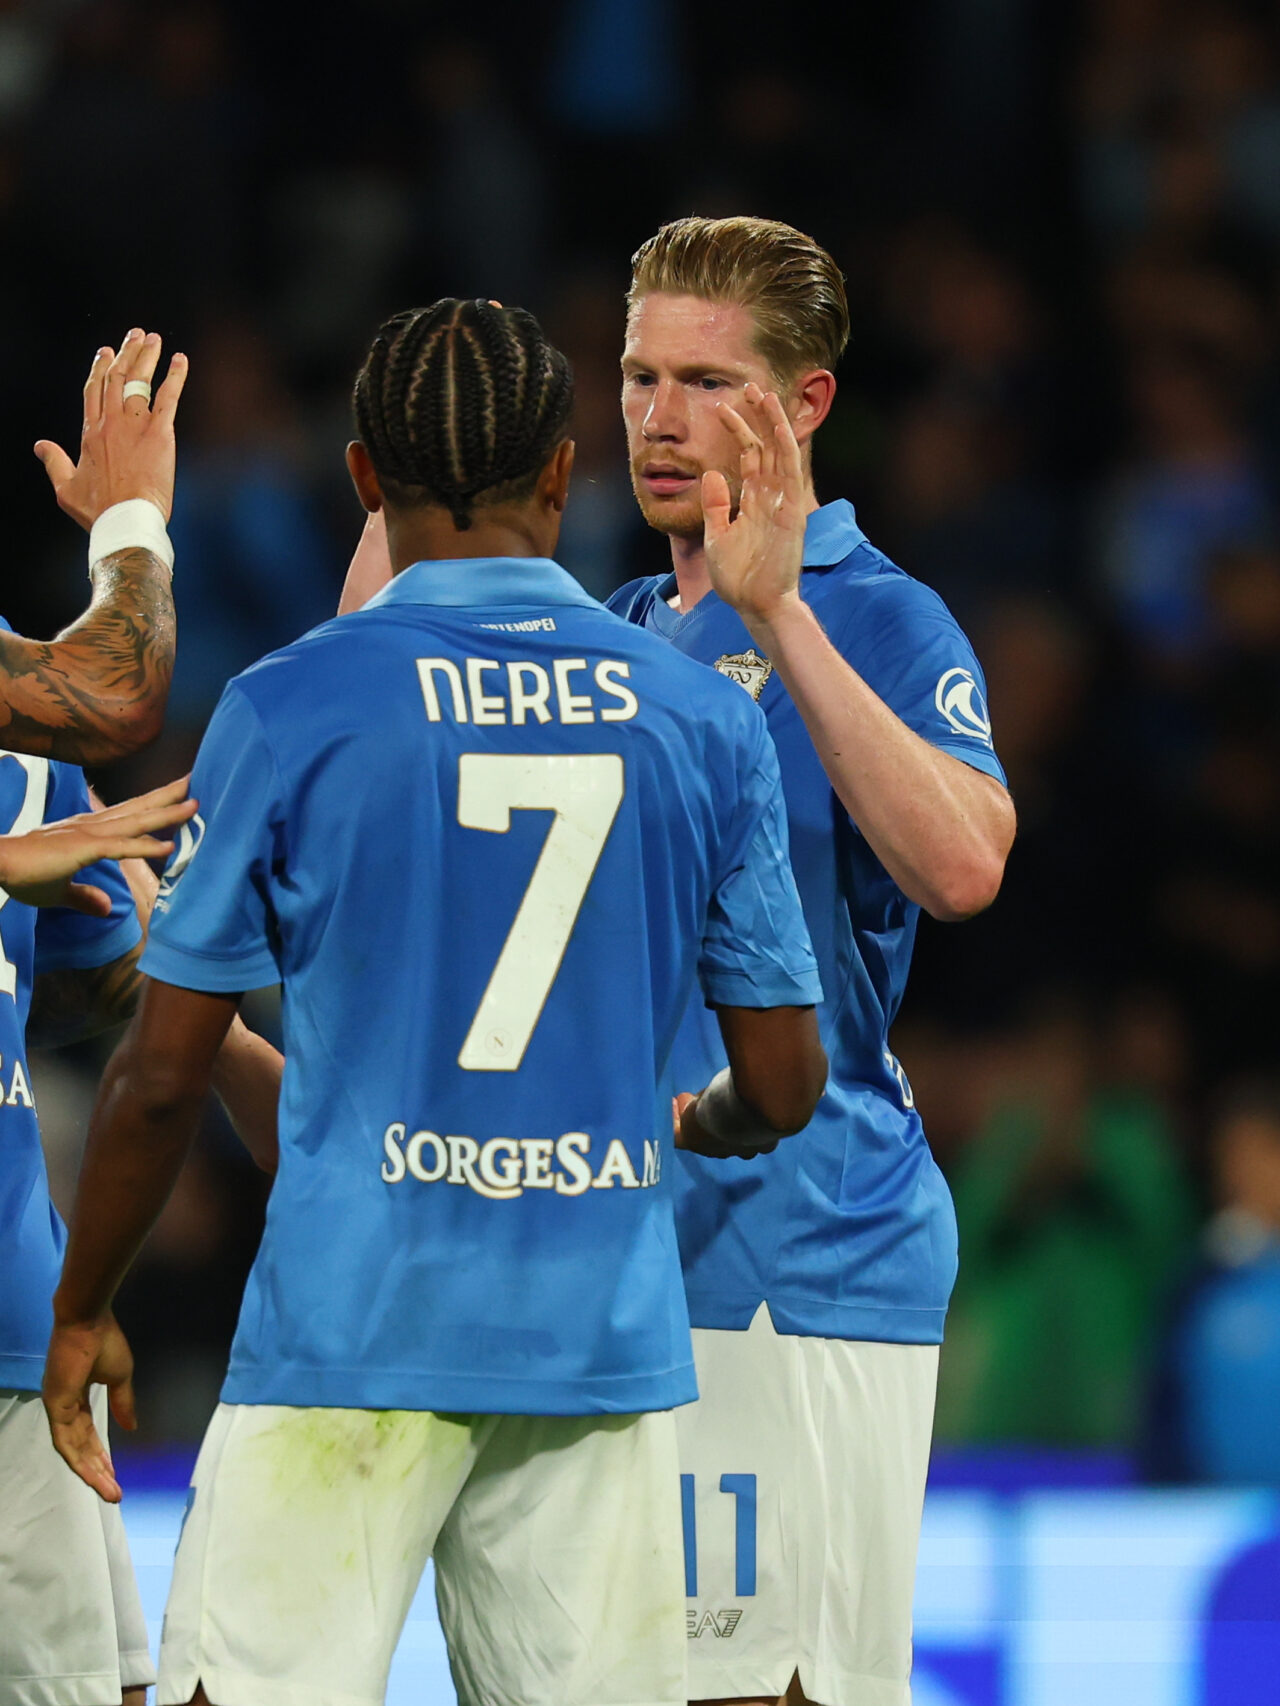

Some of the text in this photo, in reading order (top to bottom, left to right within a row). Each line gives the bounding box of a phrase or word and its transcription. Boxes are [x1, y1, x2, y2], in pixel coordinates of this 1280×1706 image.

[417, 657, 638, 724] NERES
[458, 754, 623, 1070] 7
[381, 1122, 661, 1199] SORGESAN
